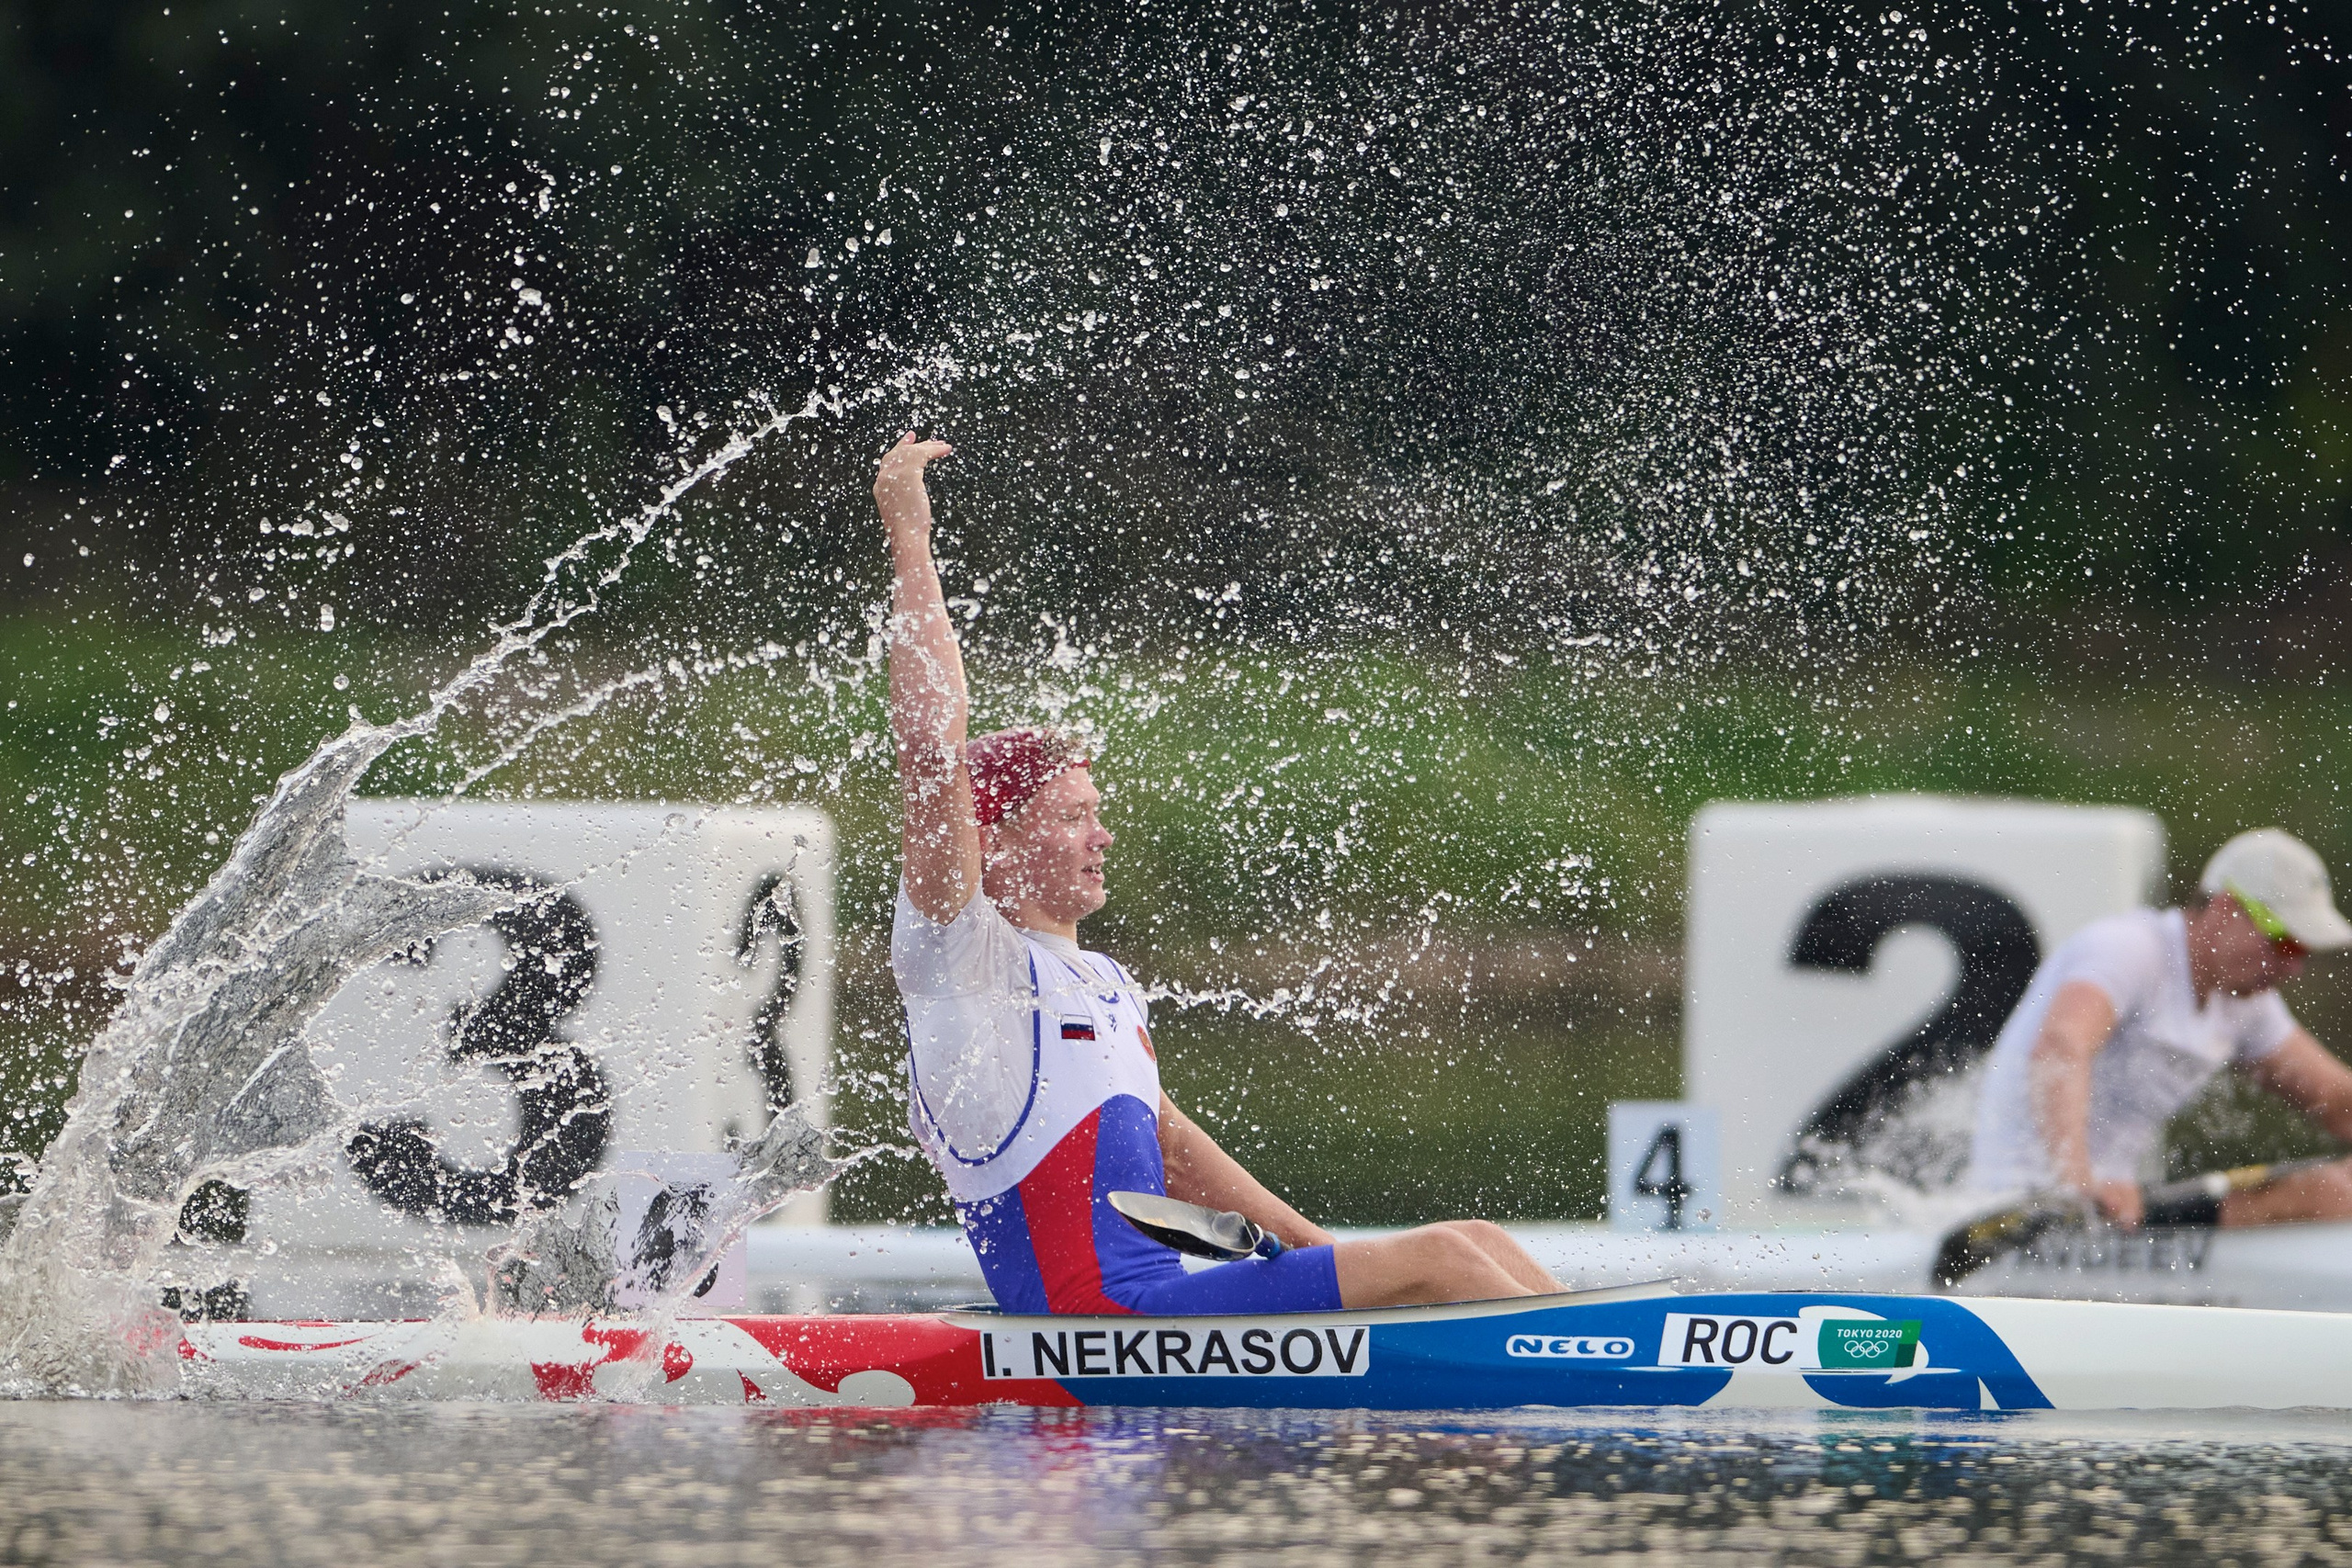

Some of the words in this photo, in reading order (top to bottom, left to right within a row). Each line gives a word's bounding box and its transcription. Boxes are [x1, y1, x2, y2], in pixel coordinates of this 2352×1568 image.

[344, 863, 610, 1224] 3
[1775, 868, 2040, 1199] 2
[1634, 1125, 1689, 1230] 4
[983, 1333, 1012, 1377] I.
[1033, 1328, 1366, 1376] NEKRASOV
[1512, 1337, 1628, 1355] NELO
[1681, 1317, 1798, 1365] ROC
[1837, 1328, 1873, 1338] TOKYO
[1874, 1329, 1904, 1338] 2020
